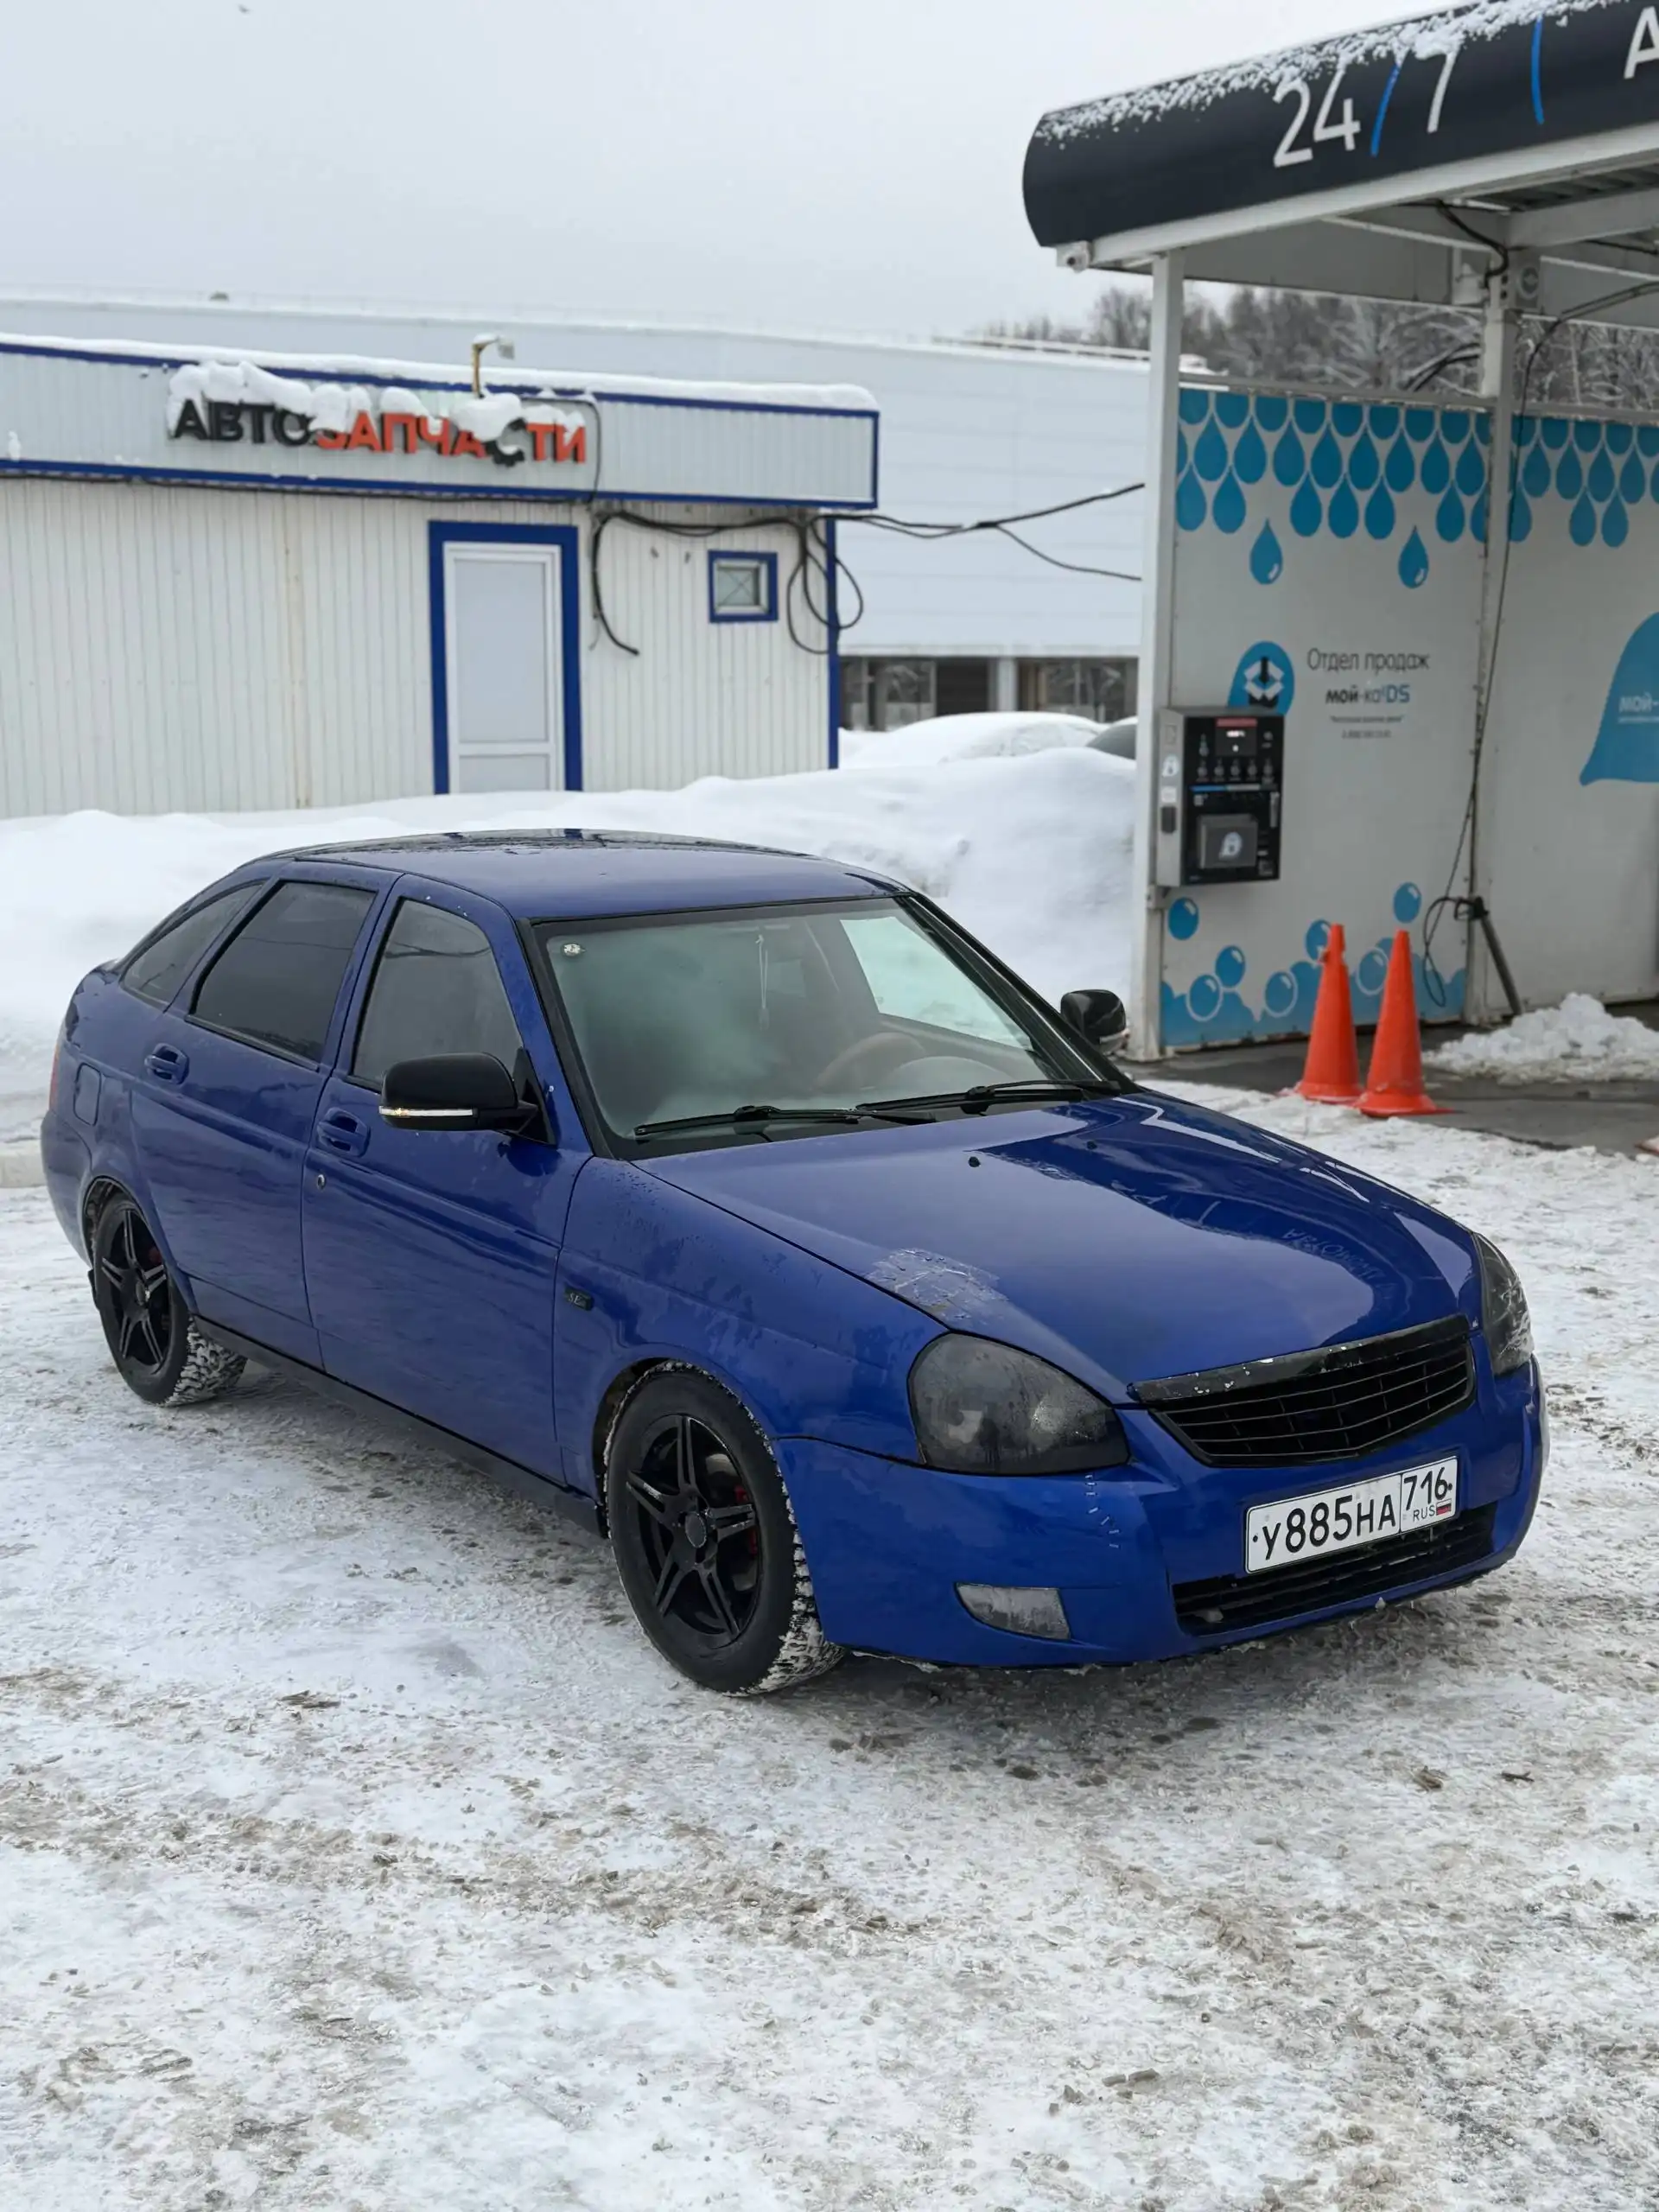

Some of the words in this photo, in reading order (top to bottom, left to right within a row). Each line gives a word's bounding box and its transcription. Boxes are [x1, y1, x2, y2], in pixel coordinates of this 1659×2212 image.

[1306, 647, 1360, 672] Отдел
[1364, 652, 1431, 677] продаж
[1262, 1494, 1396, 1560] У885НА
[1403, 1466, 1449, 1511] 716
[1413, 1503, 1436, 1522] RUS
